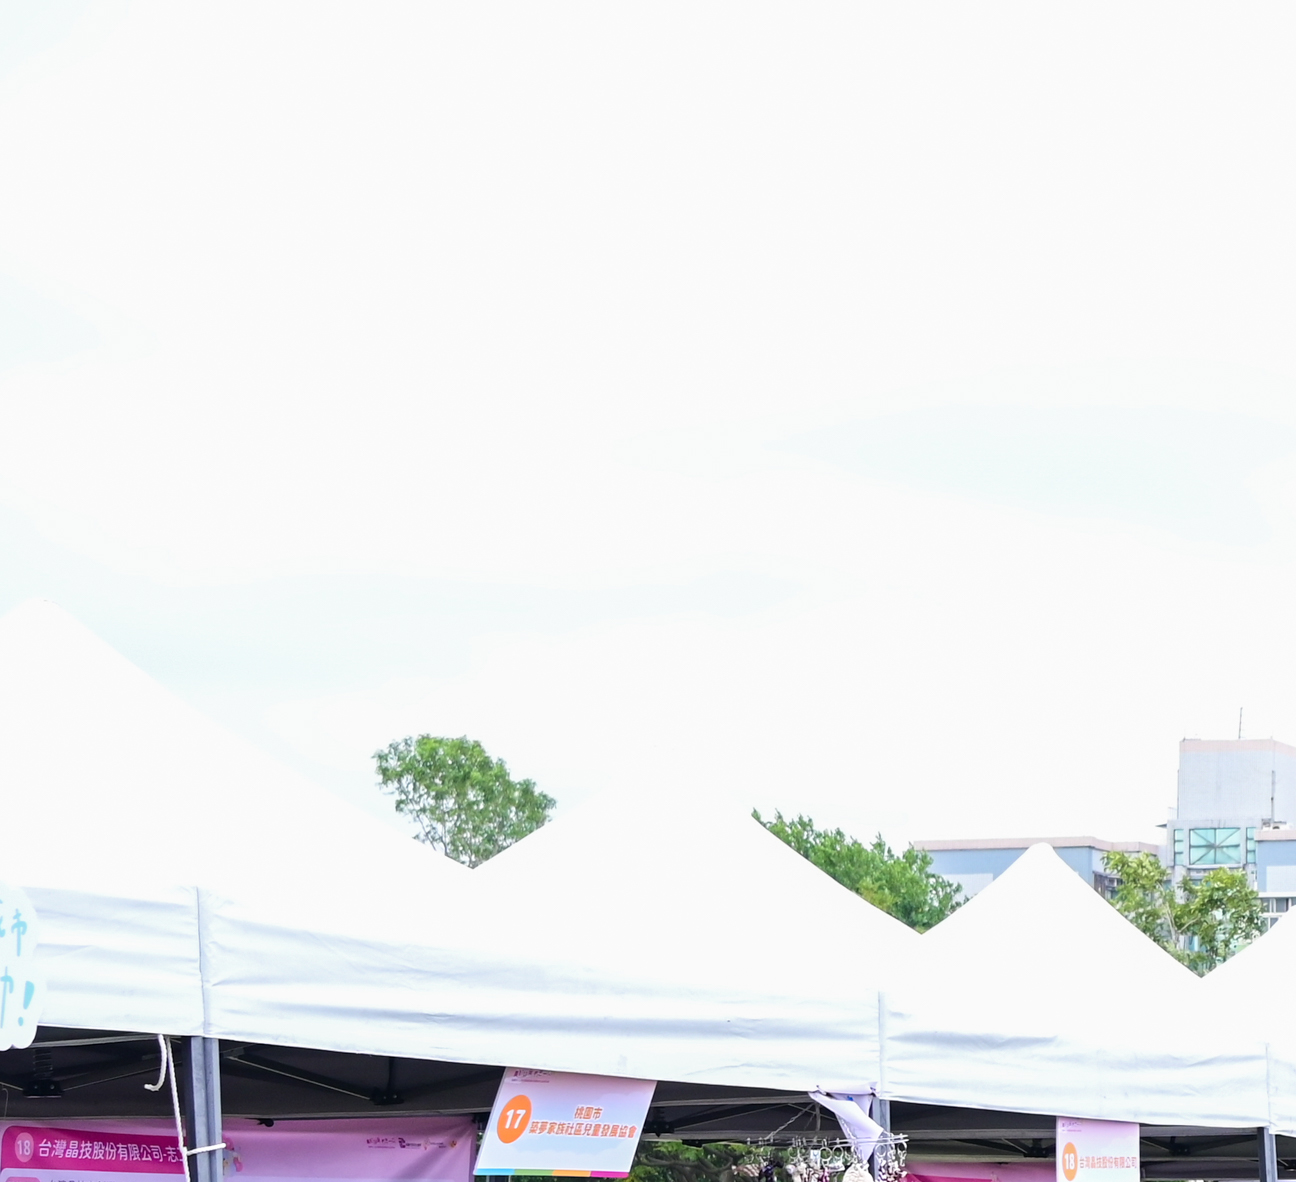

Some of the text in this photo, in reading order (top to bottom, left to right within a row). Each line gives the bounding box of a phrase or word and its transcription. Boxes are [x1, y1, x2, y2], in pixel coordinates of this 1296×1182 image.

[505, 1109, 527, 1129] 17
[574, 1106, 603, 1120] 桃園市
[528, 1121, 637, 1138] 築夢家族社區兒童發展協會
[17, 1140, 31, 1156] 18
[1064, 1153, 1137, 1170] 18 台灣晶技股份有限公司
